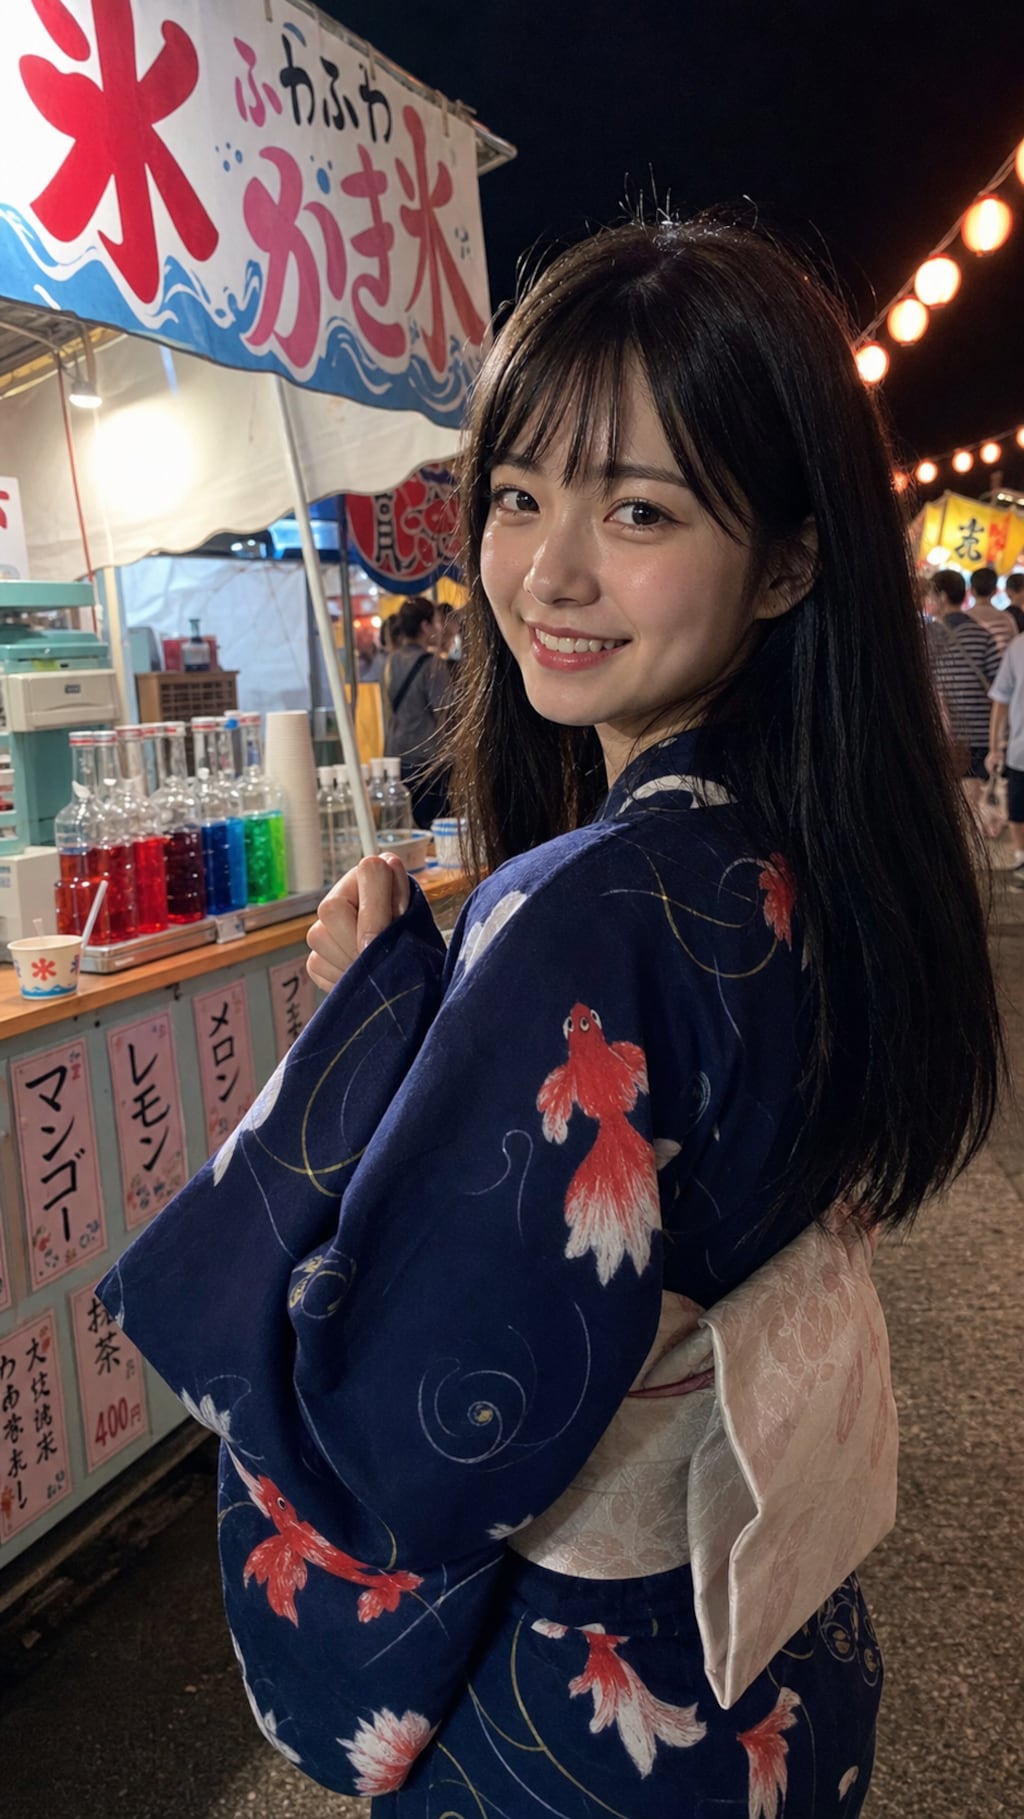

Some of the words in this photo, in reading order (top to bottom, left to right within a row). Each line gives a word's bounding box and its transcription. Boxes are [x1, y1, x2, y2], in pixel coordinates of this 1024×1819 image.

[19, 0, 219, 304] 氷
[233, 33, 392, 143] ふわふわ
[242, 104, 487, 374] かき氷
[128, 1043, 172, 1172] レモン
[209, 1002, 241, 1103] メロン
[25, 1065, 86, 1242] マンゴー
